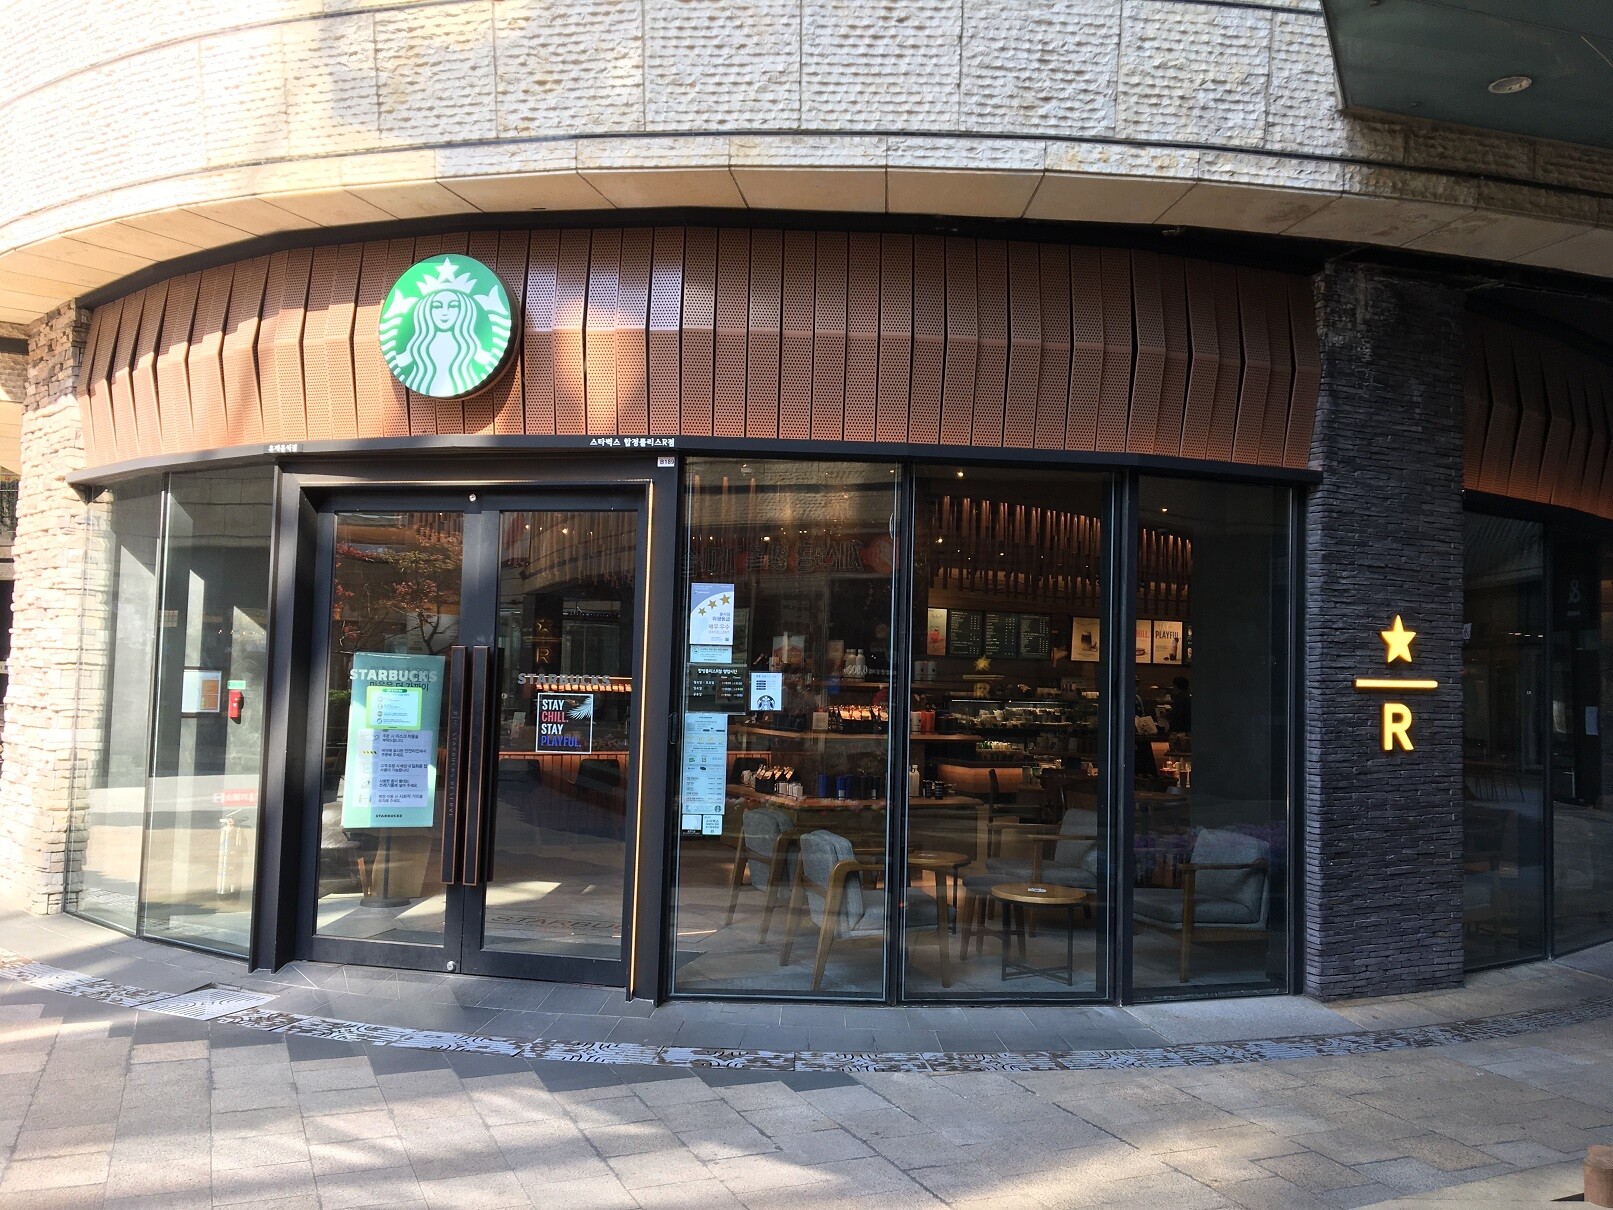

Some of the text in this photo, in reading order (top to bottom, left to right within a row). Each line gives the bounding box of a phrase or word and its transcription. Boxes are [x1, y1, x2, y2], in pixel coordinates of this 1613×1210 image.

[589, 437, 621, 447] 스타벅스
[349, 668, 438, 683] STARBUCKS
[517, 673, 611, 686] STARBUCKS
[542, 699, 565, 711] STAY
[541, 711, 569, 723] CHILL.
[541, 723, 564, 735] STAY
[1383, 702, 1415, 751] R
[541, 735, 582, 748] PLAYFUL.
[491, 915, 621, 929] STARBU
